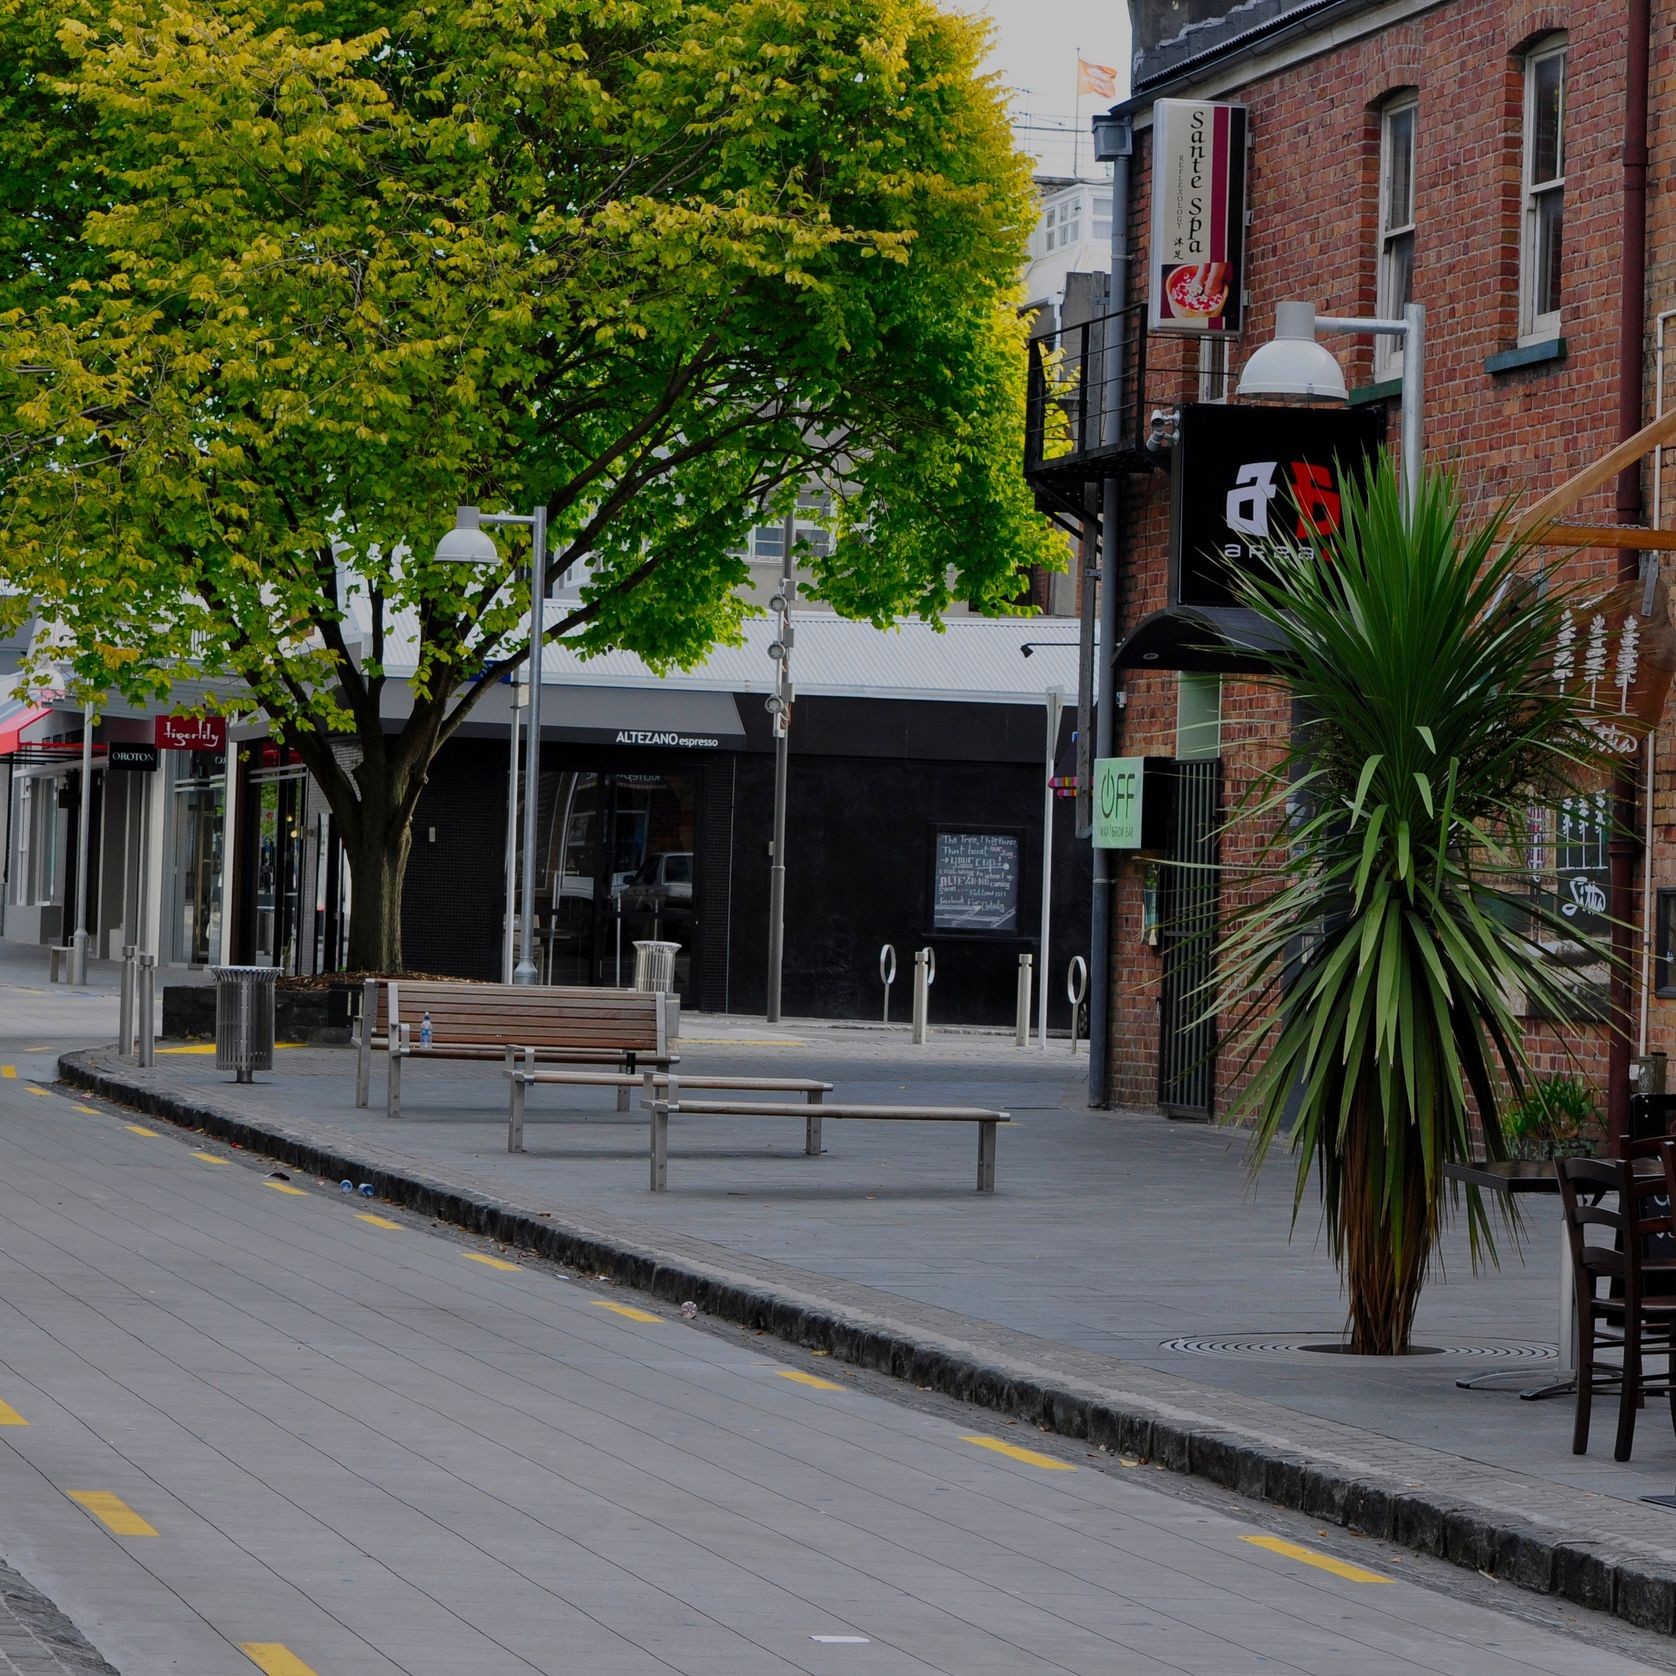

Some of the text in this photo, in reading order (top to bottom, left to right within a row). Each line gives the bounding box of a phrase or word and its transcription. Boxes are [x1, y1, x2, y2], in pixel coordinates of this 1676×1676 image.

[1176, 155, 1184, 229] REFLEXOLOGY
[1188, 111, 1206, 253] Sante Spa
[112, 751, 154, 763] OROTON
[615, 731, 718, 748] ALTEZANO espresso
[1101, 767, 1135, 819] OFF
